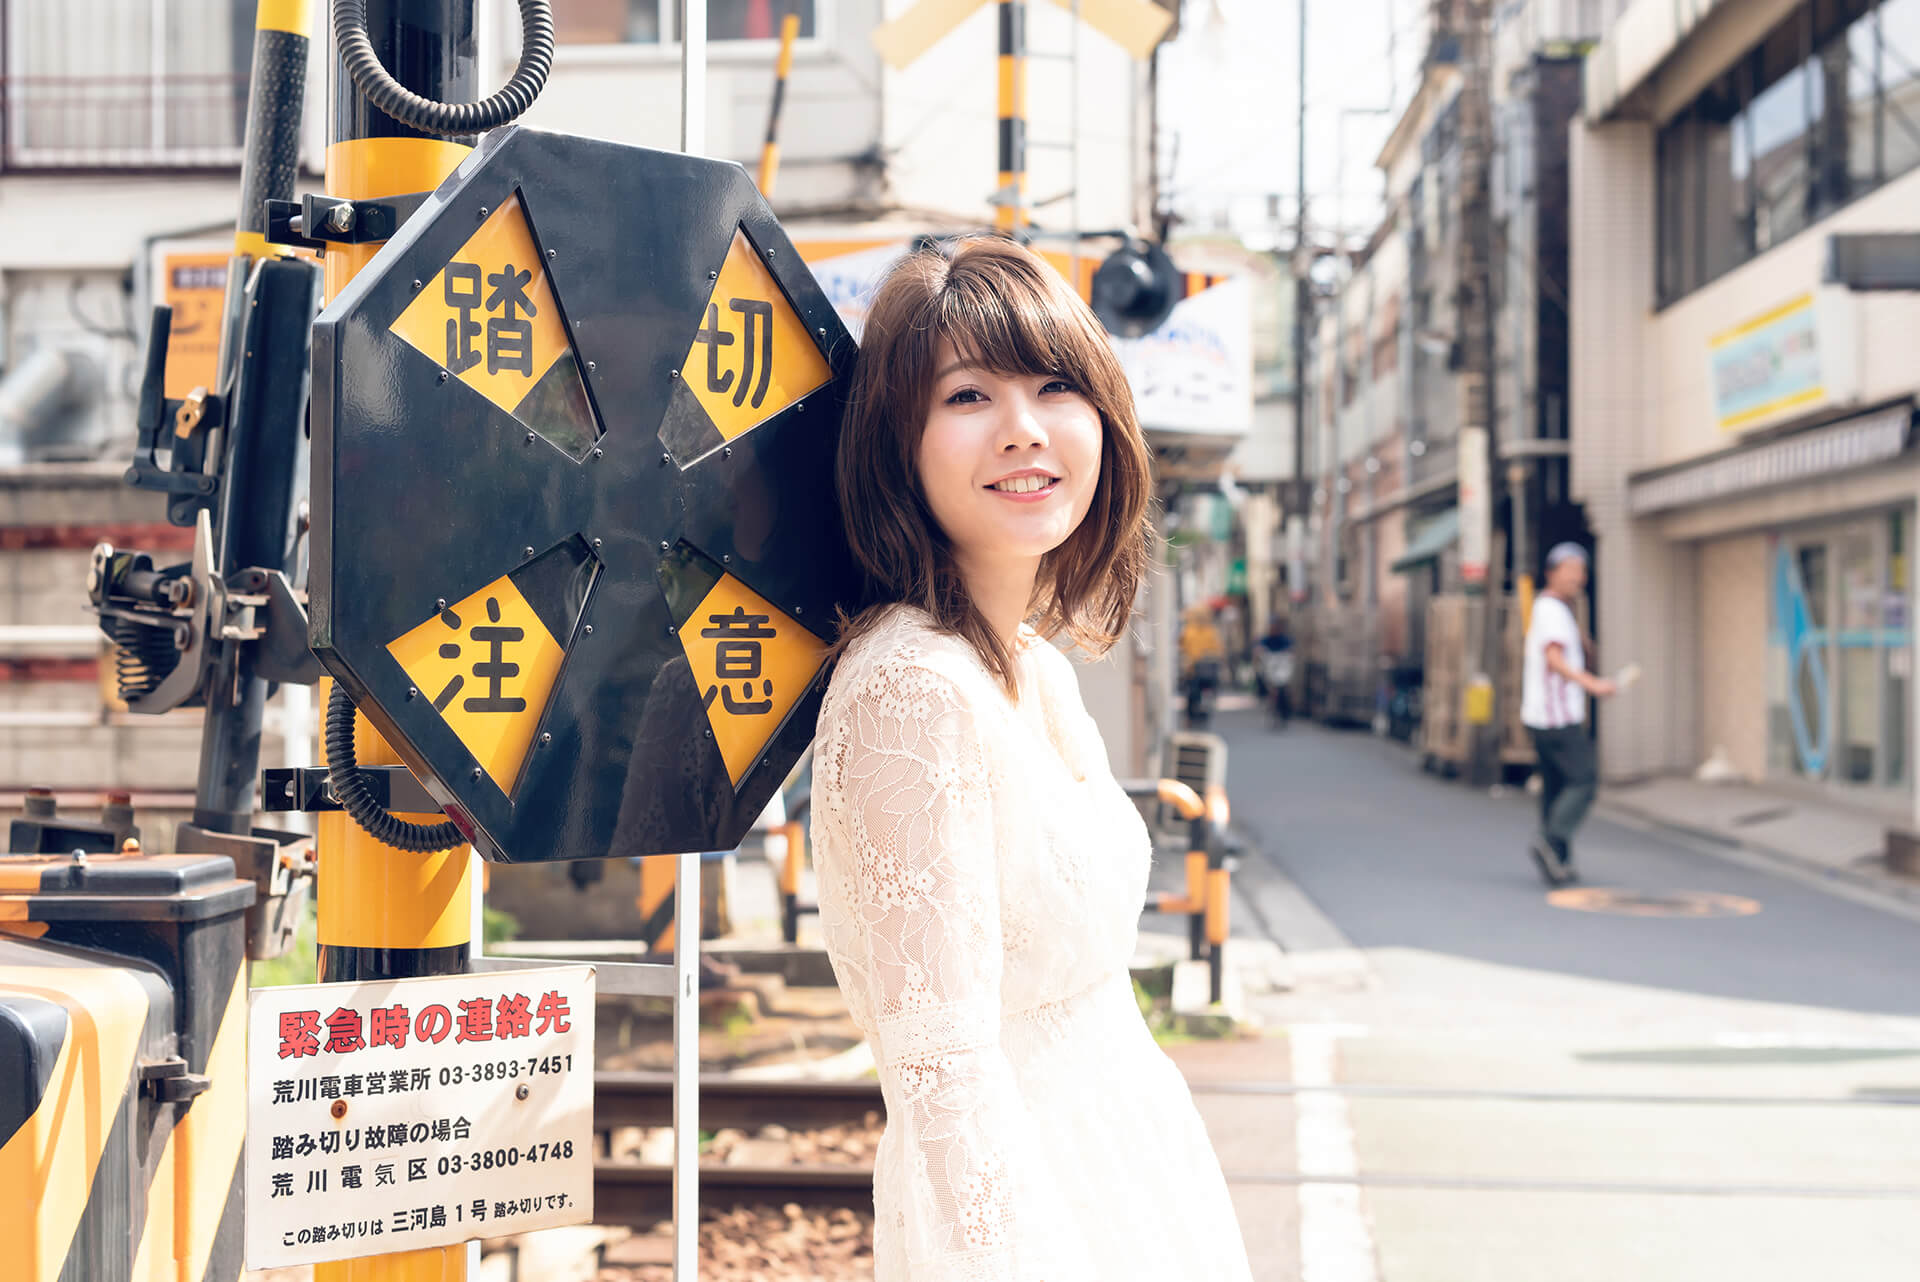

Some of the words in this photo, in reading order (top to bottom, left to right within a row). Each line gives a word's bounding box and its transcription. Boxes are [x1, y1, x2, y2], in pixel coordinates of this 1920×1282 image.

[444, 262, 537, 378] 踏
[696, 298, 773, 409] 切
[433, 597, 527, 713] 注
[701, 606, 777, 715] 意
[277, 990, 571, 1059] 緊急時の連絡先
[272, 1067, 431, 1105] 荒川電車営業所
[439, 1054, 572, 1086] 03-3893-7451
[271, 1116, 471, 1160] 踏み切り故障の場合
[437, 1140, 573, 1175] 03-3800-4748
[283, 1218, 384, 1246] この踏み切りは
